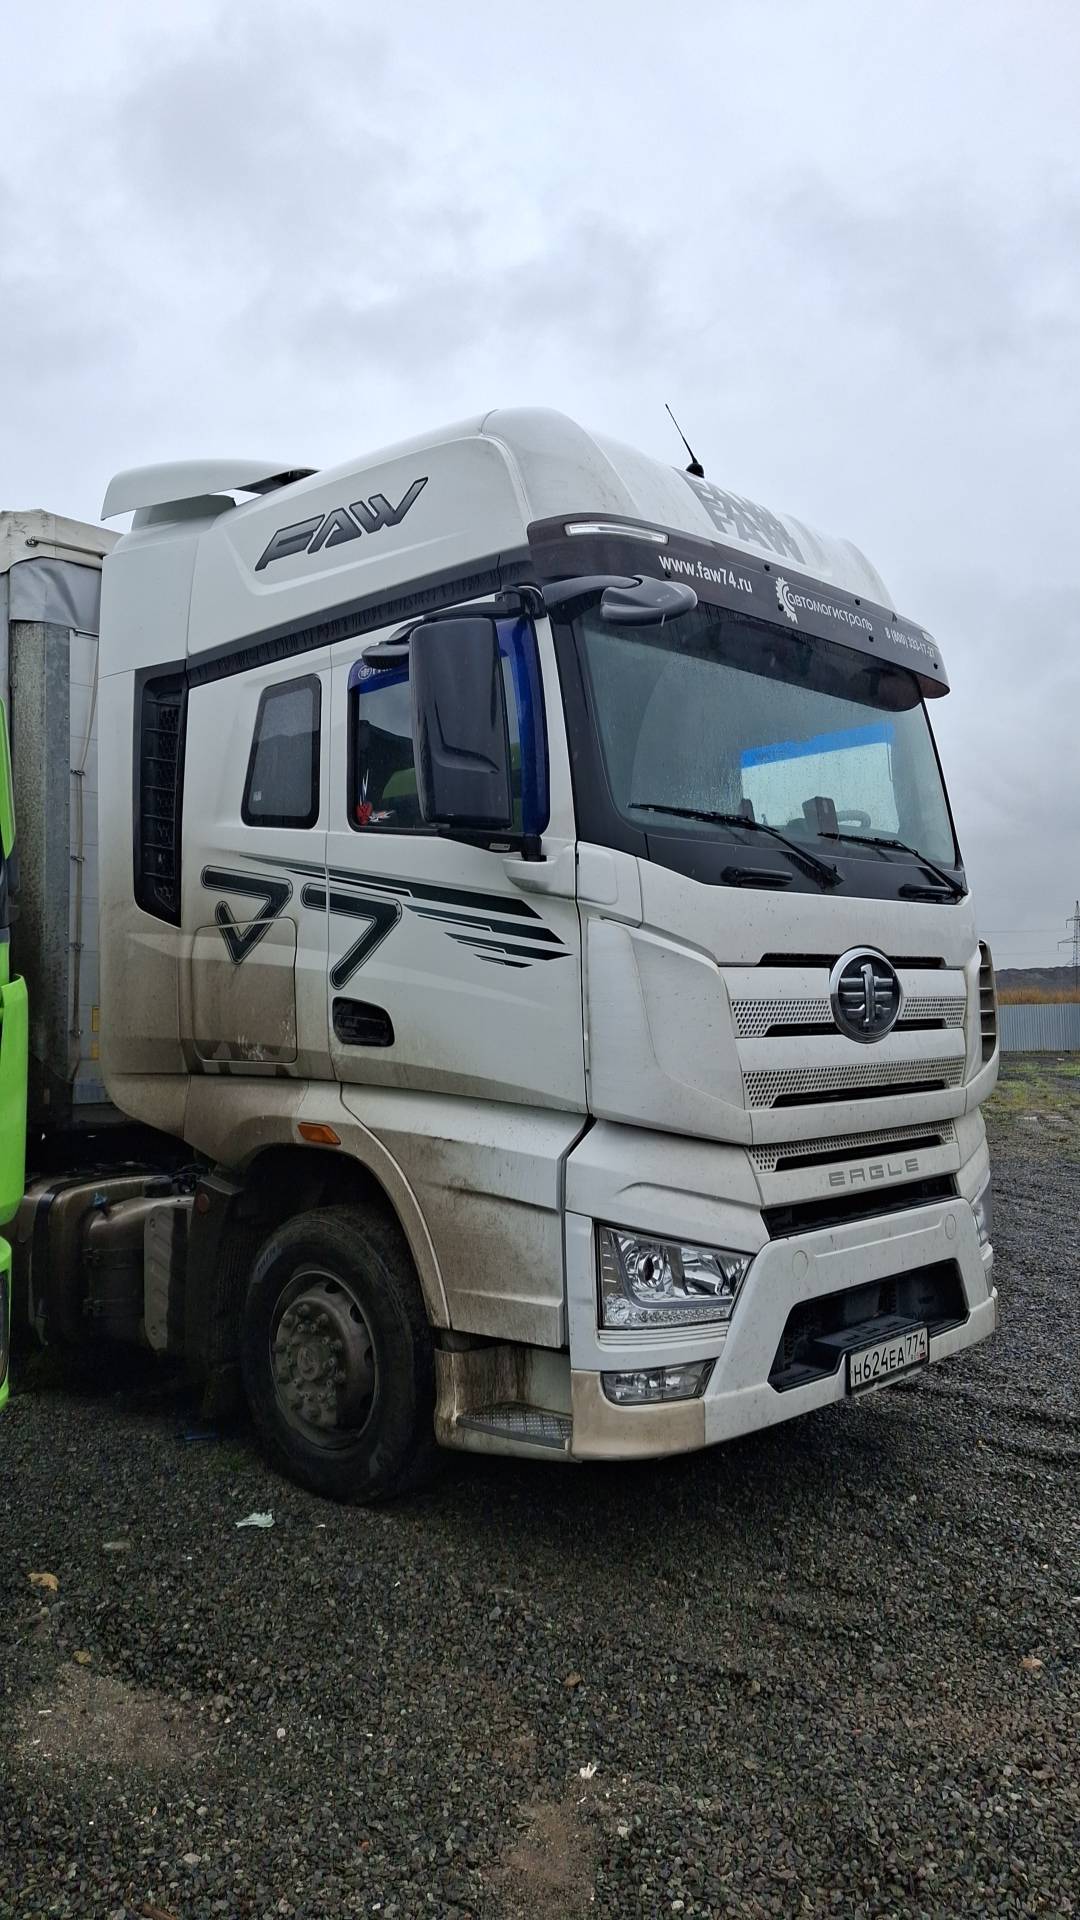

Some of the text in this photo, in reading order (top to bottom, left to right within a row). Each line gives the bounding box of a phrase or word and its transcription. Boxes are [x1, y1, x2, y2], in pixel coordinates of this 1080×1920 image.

[255, 476, 428, 571] FAW
[659, 555, 753, 594] www.faw74.ru
[829, 1158, 919, 1187] EAGLE
